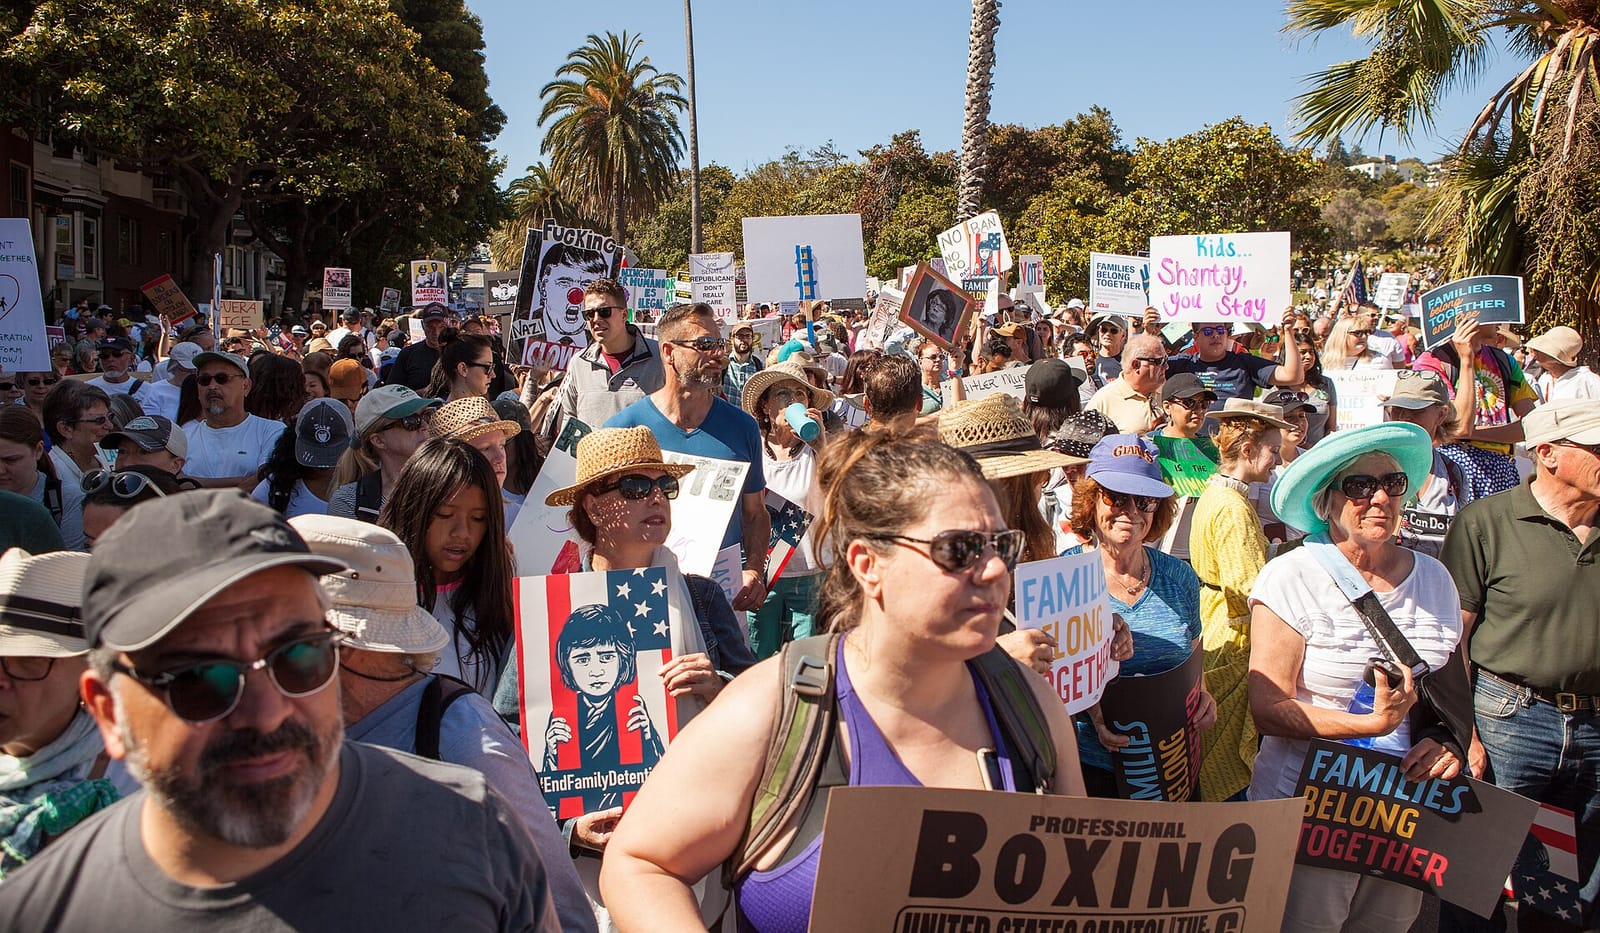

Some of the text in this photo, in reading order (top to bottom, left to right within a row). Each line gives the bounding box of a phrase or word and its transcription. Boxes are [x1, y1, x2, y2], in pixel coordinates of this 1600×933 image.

[941, 215, 997, 251] NO BAN
[1020, 261, 1043, 286] VOTE
[1096, 262, 1136, 273] FAMILIES
[1096, 270, 1131, 281] BELONG
[964, 281, 989, 291] FAMIL
[1096, 279, 1141, 291] TOGETHER
[220, 301, 257, 315] UERA
[1216, 295, 1267, 322] Stay
[1427, 284, 1493, 311] FAMILIES
[222, 315, 252, 326] ICE
[717, 308, 731, 318] U?
[1428, 299, 1506, 327] TOGETHER
[512, 321, 543, 339] NAZI
[0, 355, 22, 364] OW!
[525, 340, 577, 372] CLOW
[1112, 444, 1154, 464] GIANS
[1173, 464, 1208, 473] IS THE
[1409, 512, 1428, 528] Can
[1429, 516, 1445, 530] Do
[1042, 604, 1103, 660] LONG
[1113, 720, 1163, 800] MILIES
[1308, 749, 1470, 815] FAMILIES
[1302, 785, 1421, 839] BELONG
[1029, 815, 1186, 839] PROFESSIONAL
[908, 809, 1257, 908] BOXING
[1299, 823, 1449, 887] TOGETHER
[902, 911, 991, 933] UNITED
[996, 916, 1079, 933] STATES
